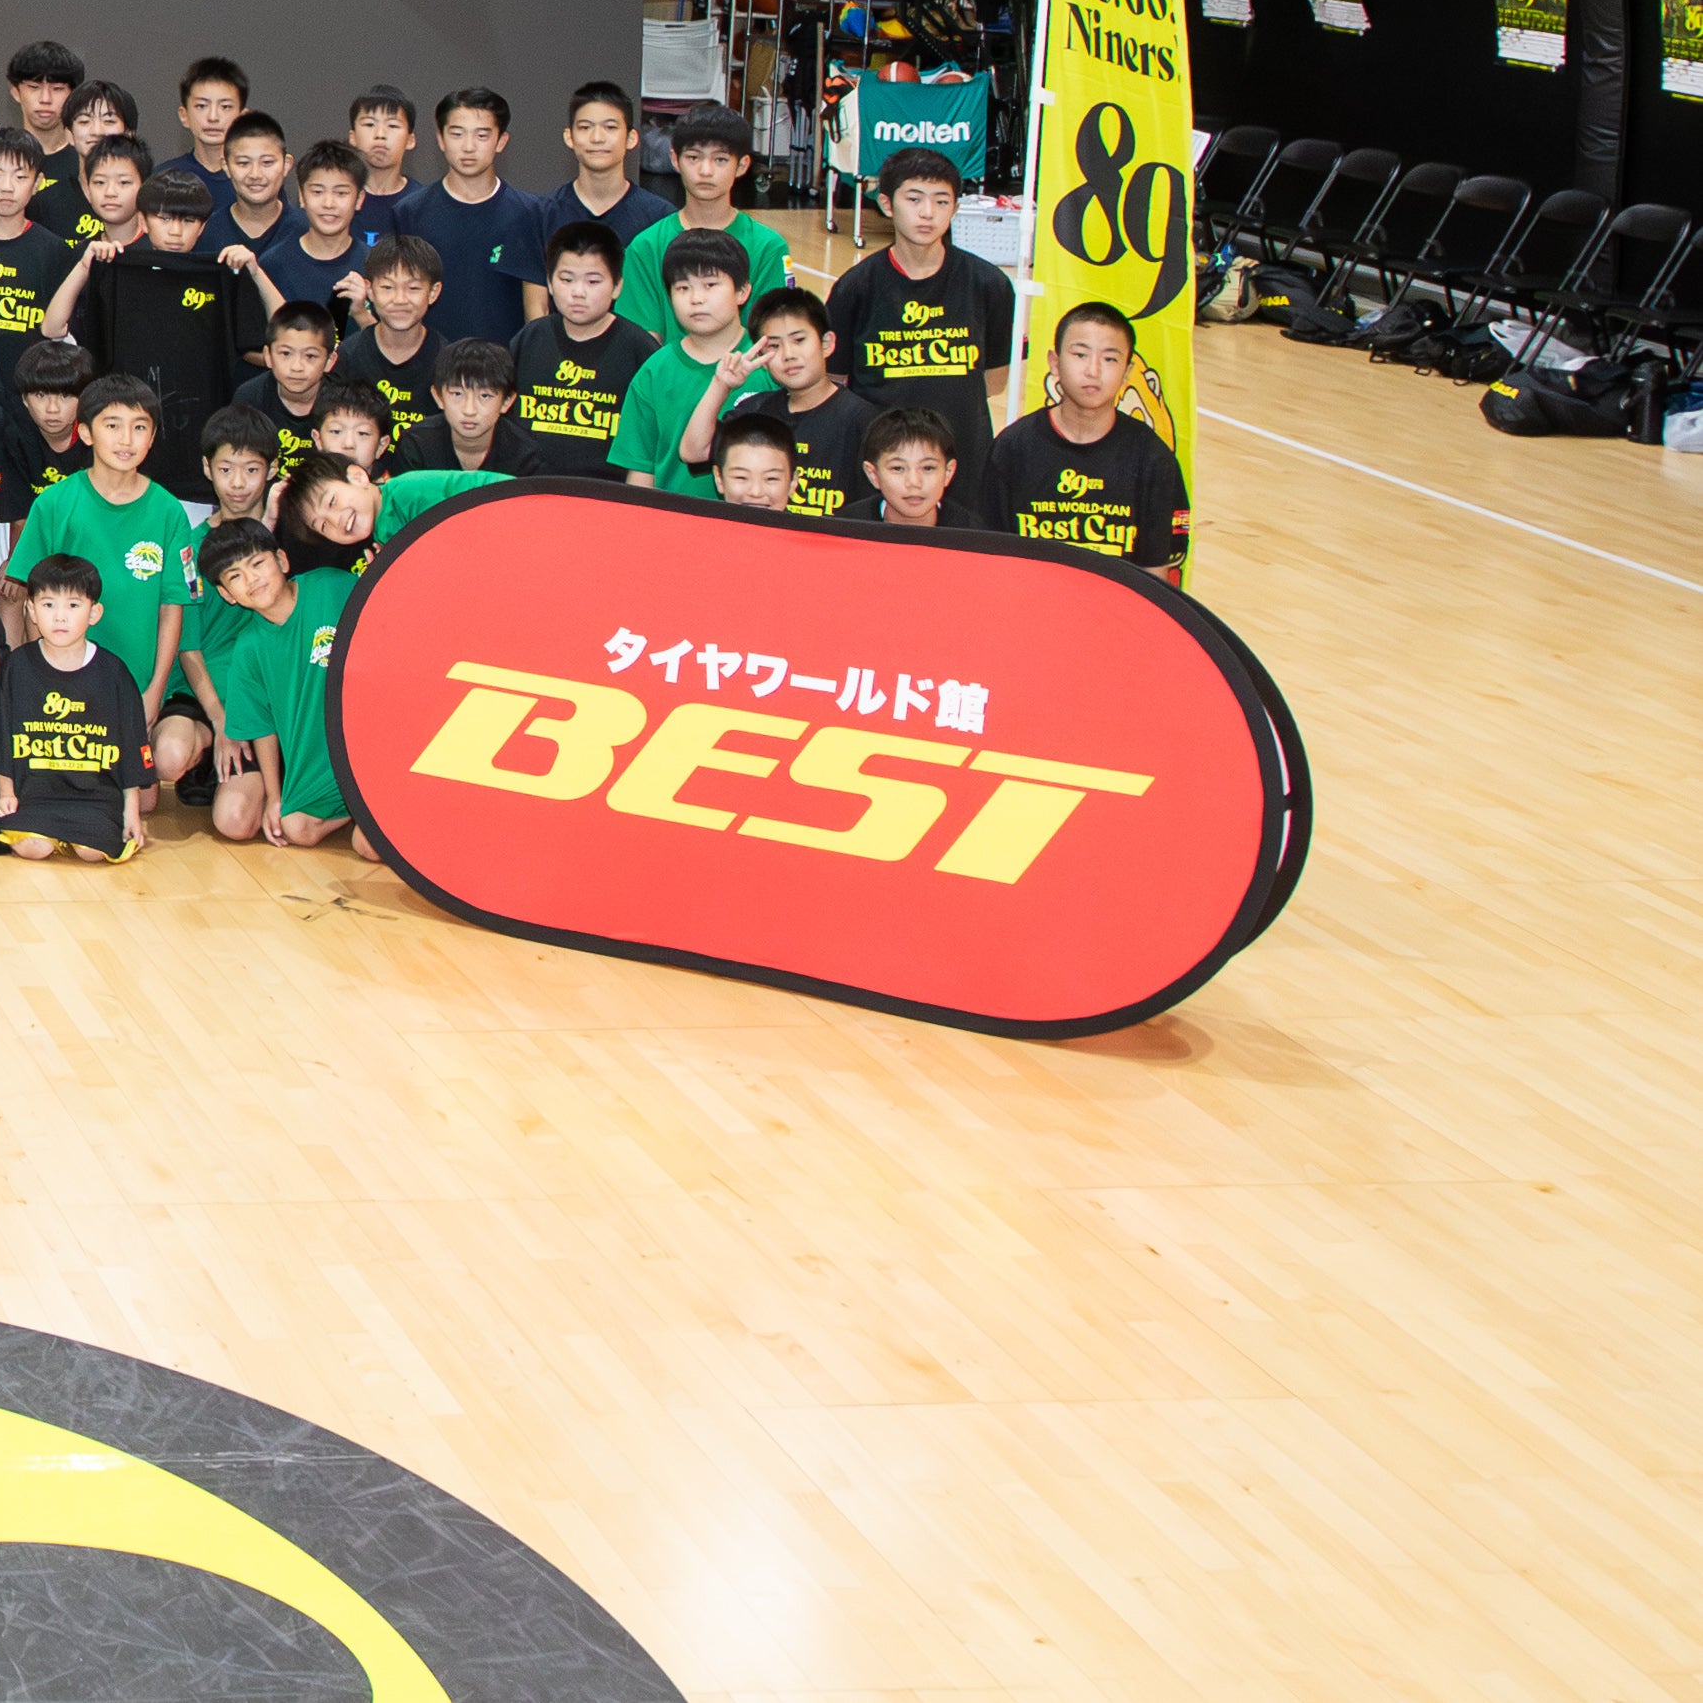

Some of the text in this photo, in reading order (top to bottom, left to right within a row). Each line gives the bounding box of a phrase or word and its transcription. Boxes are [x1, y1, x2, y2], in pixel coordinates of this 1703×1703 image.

[875, 121, 971, 144] molten
[1053, 102, 1188, 320] 89
[877, 327, 969, 342] TIRE WORLD-KAN
[864, 339, 980, 370] Best Cup
[520, 394, 570, 423] Best
[532, 385, 617, 405] TIRE WORLD-KAN
[796, 466, 832, 480] D-KAN
[1031, 501, 1131, 517] TIRE WORLD-KAN
[1016, 513, 1080, 540] Best
[1084, 515, 1138, 553] Cup
[603, 626, 990, 735] タイヤワールド館
[23, 720, 107, 736] TIRE WORLD-KAN
[12, 732, 120, 771] Best Cup
[410, 660, 1155, 884] BEST
